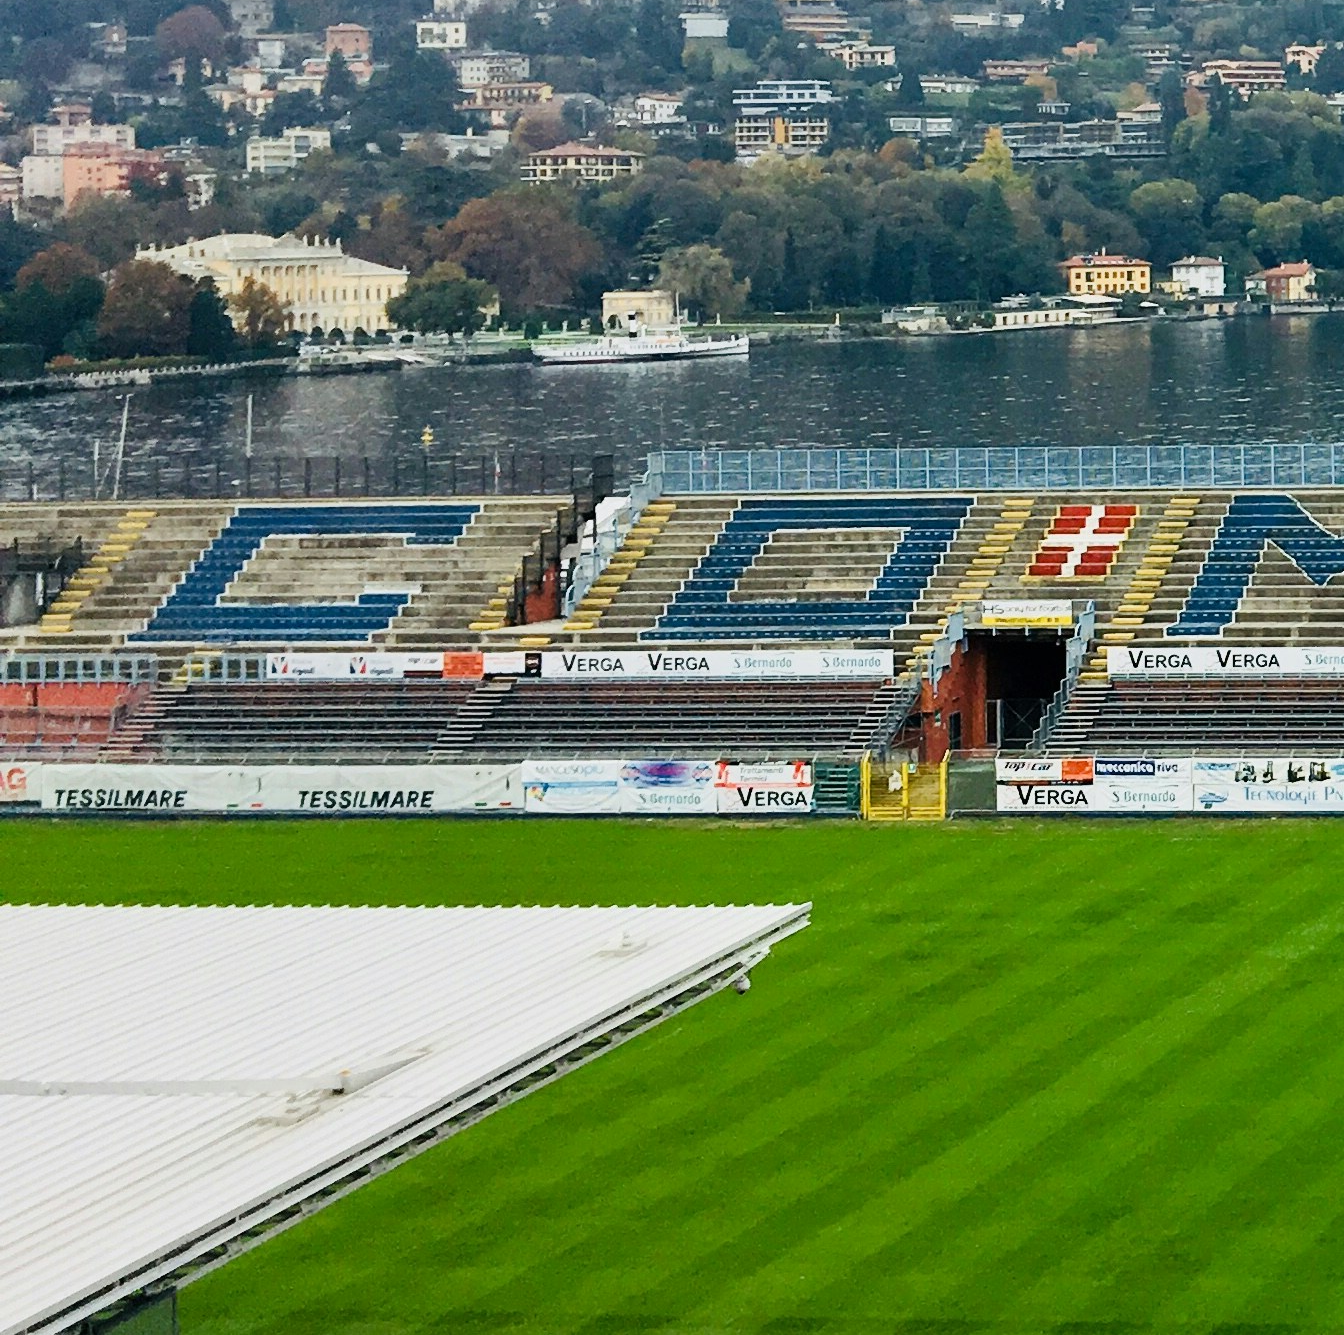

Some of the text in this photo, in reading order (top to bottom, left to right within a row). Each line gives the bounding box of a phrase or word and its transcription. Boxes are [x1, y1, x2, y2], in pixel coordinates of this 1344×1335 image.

[562, 654, 625, 672] VERGA
[648, 653, 710, 671] VERGA
[744, 657, 792, 668] Bernardo
[832, 656, 881, 667] Bernardo
[1128, 650, 1192, 669] VERGA
[1216, 649, 1280, 668] VERGA
[54, 789, 188, 808] TESSILMARE
[298, 790, 434, 809] TESSILMARE
[649, 793, 701, 805] Bernardo
[737, 787, 808, 806] VERGA
[1016, 786, 1089, 805] VERGA
[1124, 789, 1176, 803] Bernardo
